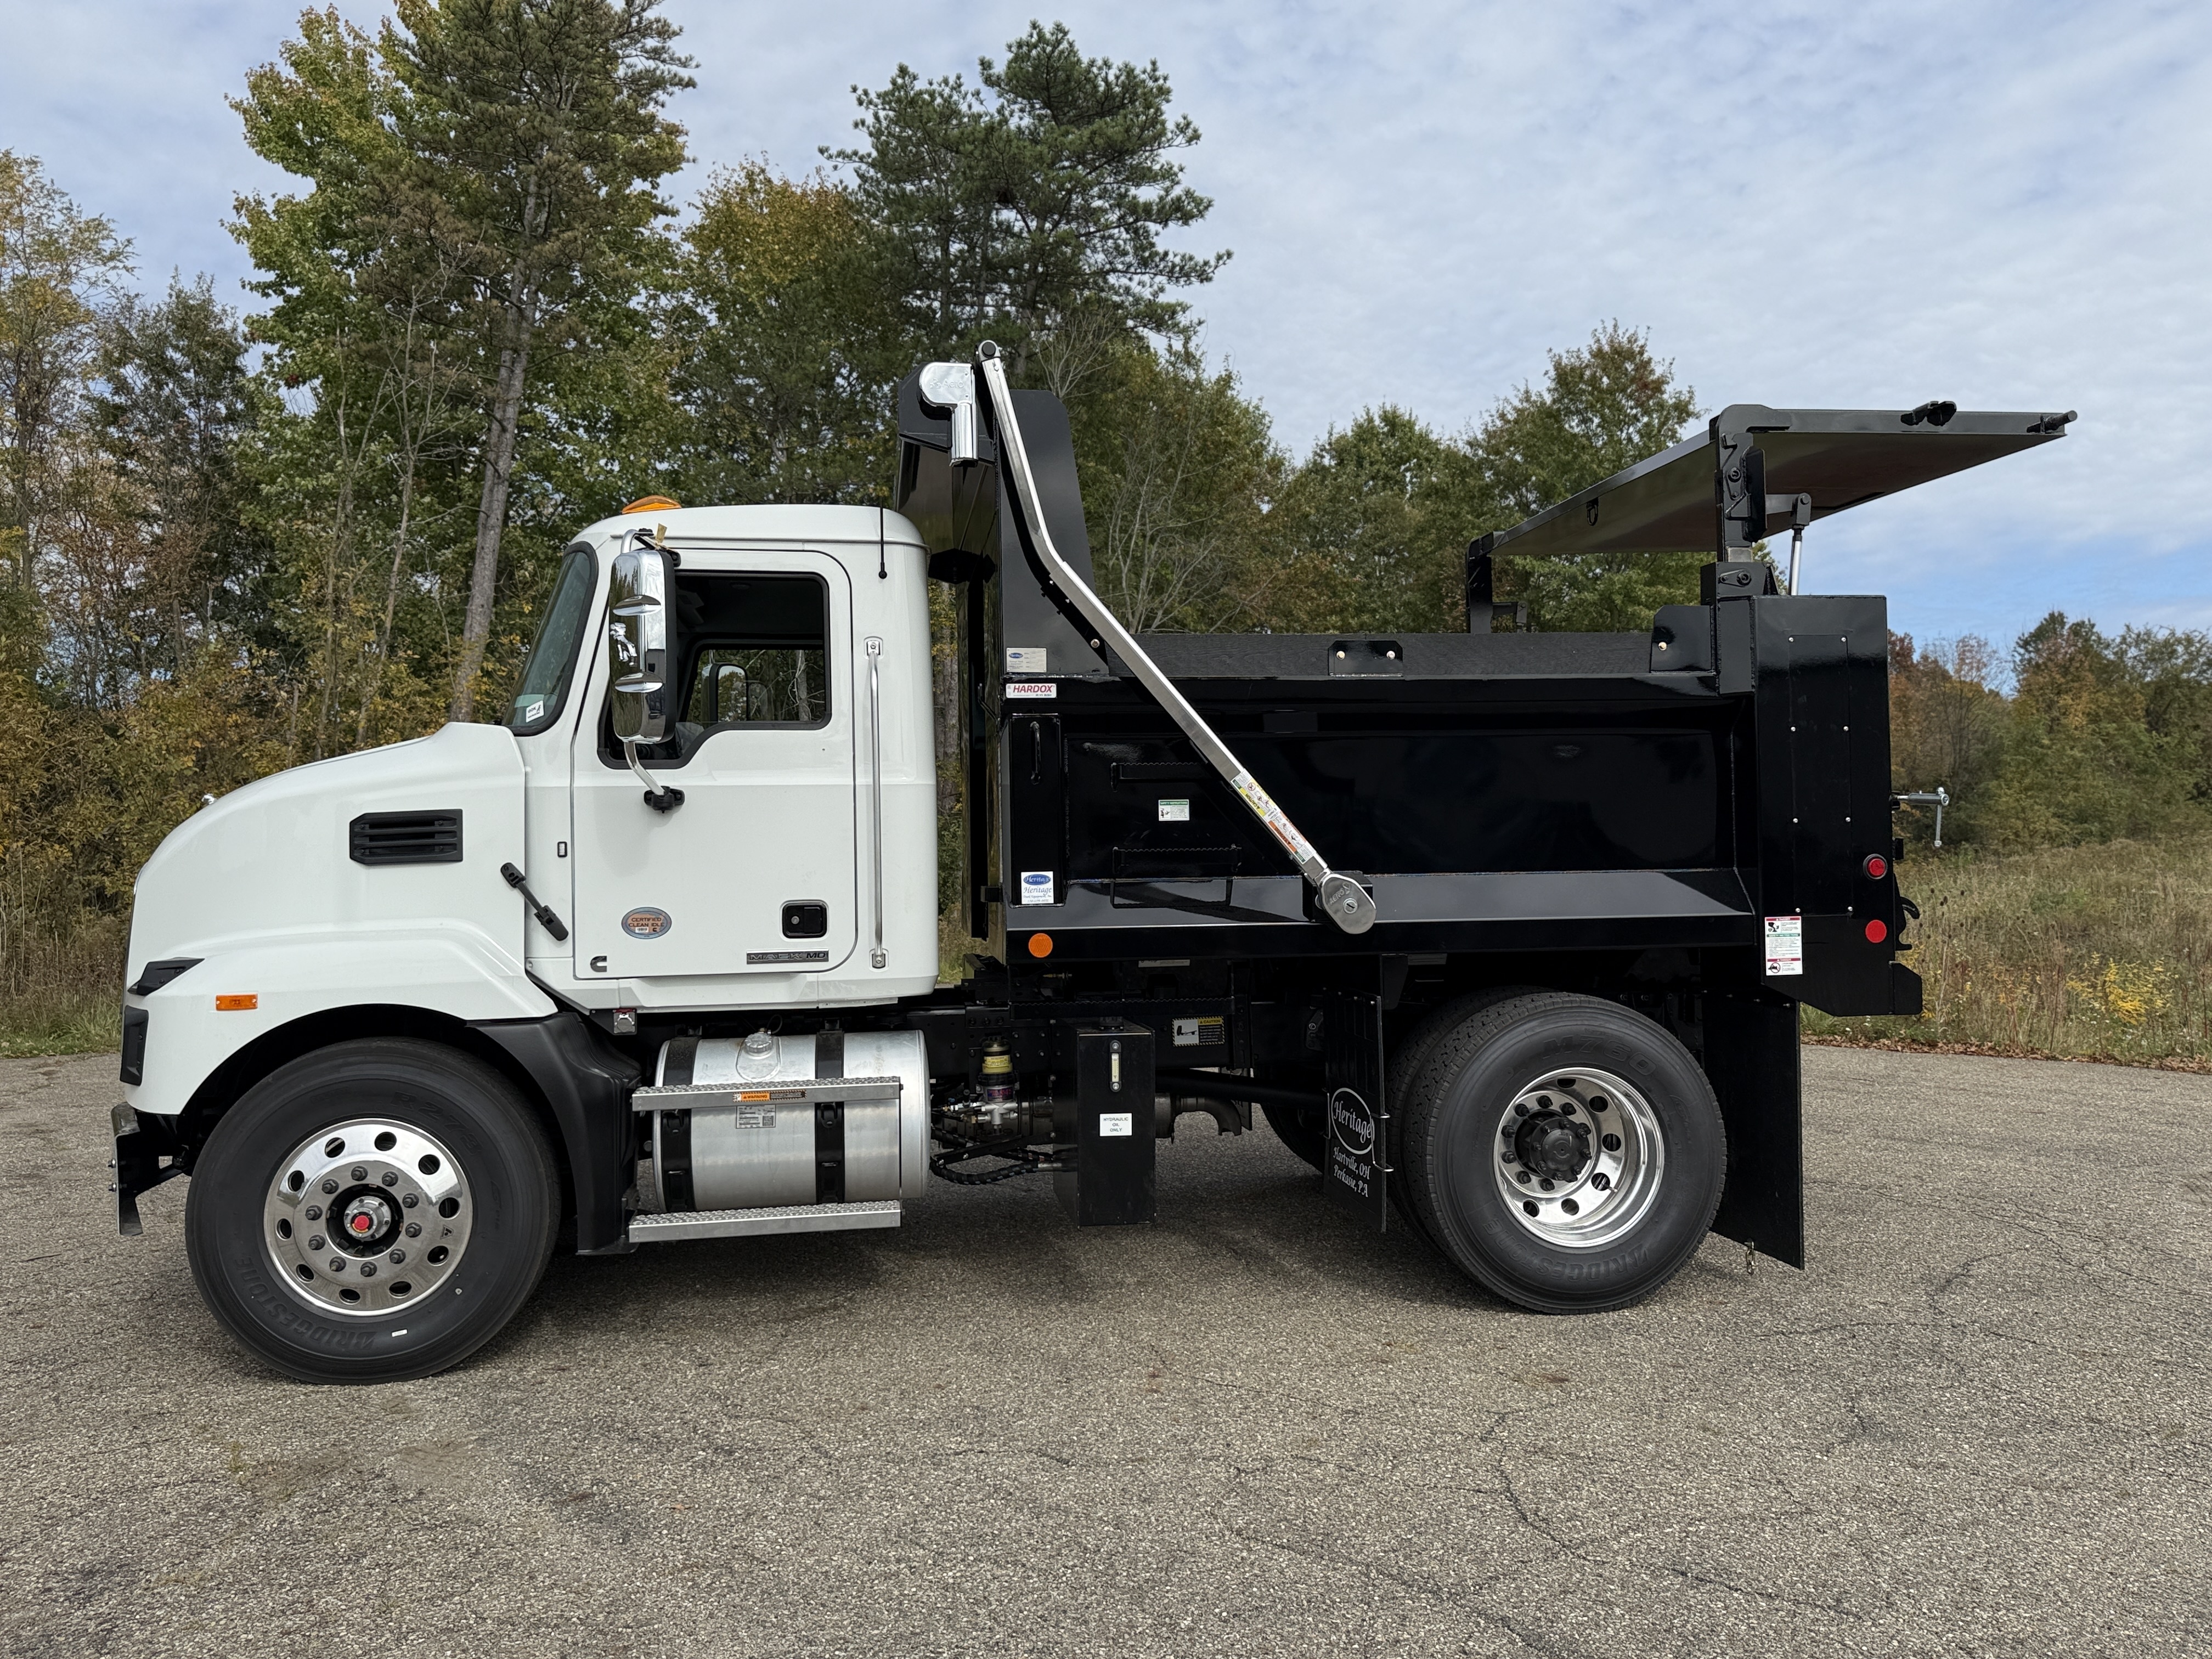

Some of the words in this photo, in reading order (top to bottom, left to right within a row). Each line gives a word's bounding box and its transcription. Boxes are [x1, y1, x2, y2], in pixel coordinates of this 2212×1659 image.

[1013, 685, 1053, 693] HARDOX
[1023, 886, 1052, 896] Heritage
[1329, 888, 1345, 905] AERO
[1333, 1101, 1372, 1143] Heritage
[1333, 1147, 1358, 1175] Hartville,
[1359, 1163, 1371, 1180] OH
[1333, 1164, 1357, 1192] Perkasie,
[1358, 1180, 1369, 1198] PA
[1483, 1218, 1649, 1282] BRIDGESTONE
[234, 1255, 379, 1351] BRIDGESTONE
